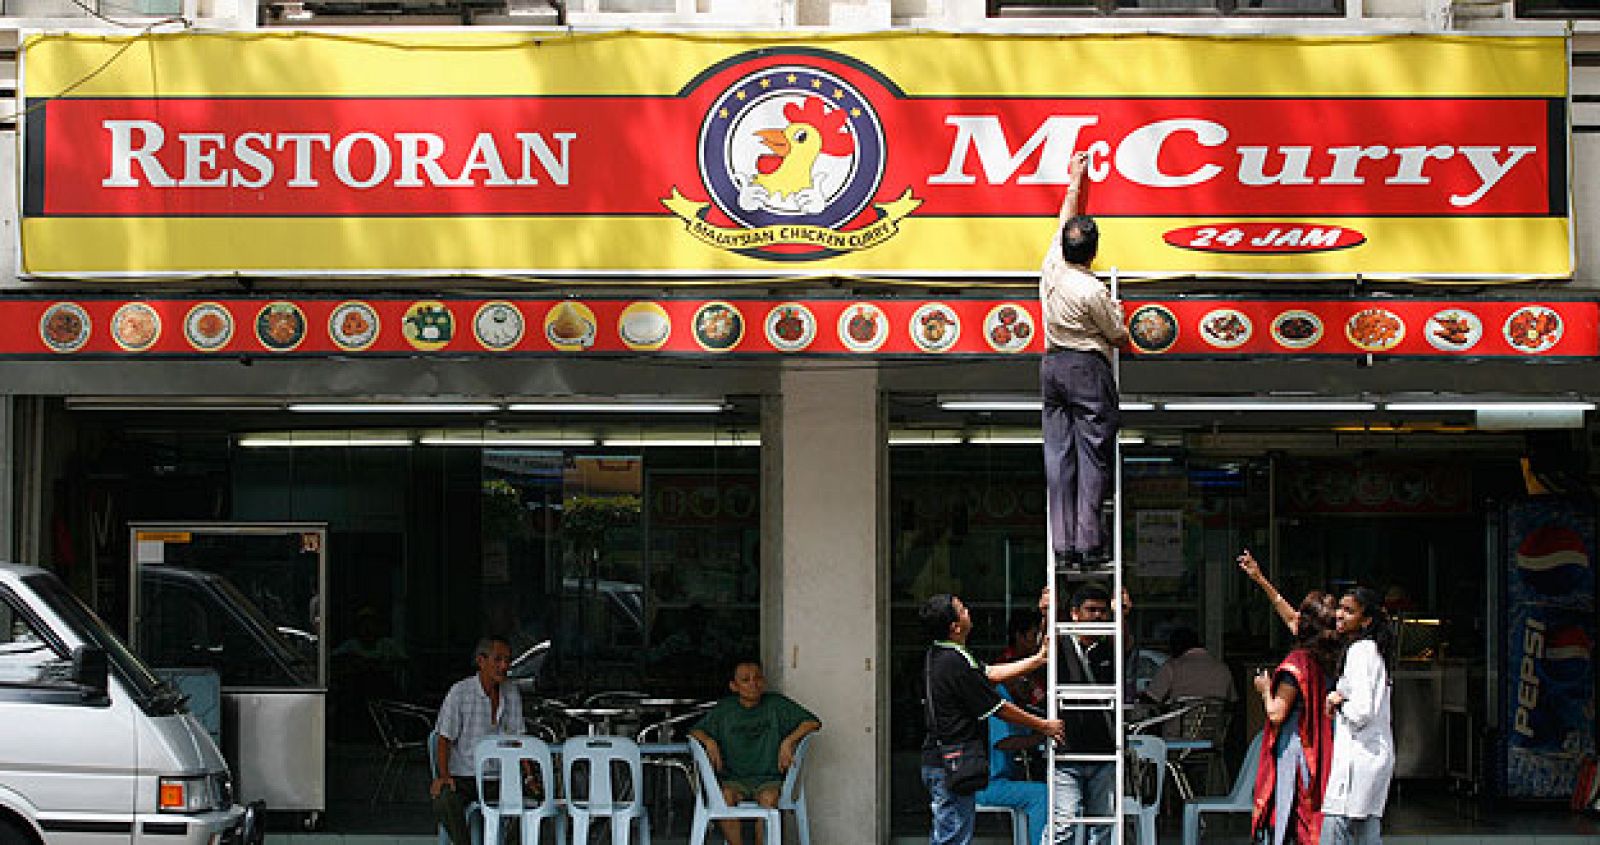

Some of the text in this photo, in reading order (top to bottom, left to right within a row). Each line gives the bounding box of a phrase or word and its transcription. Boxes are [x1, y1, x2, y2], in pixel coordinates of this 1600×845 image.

[102, 119, 577, 188] RESTORAN
[927, 115, 1537, 206] McCurry
[694, 222, 774, 246] MALAYSIAN
[780, 227, 846, 246] CHICKEN
[1189, 227, 1342, 247] 24 JAM
[1513, 617, 1546, 737] PEPSI
